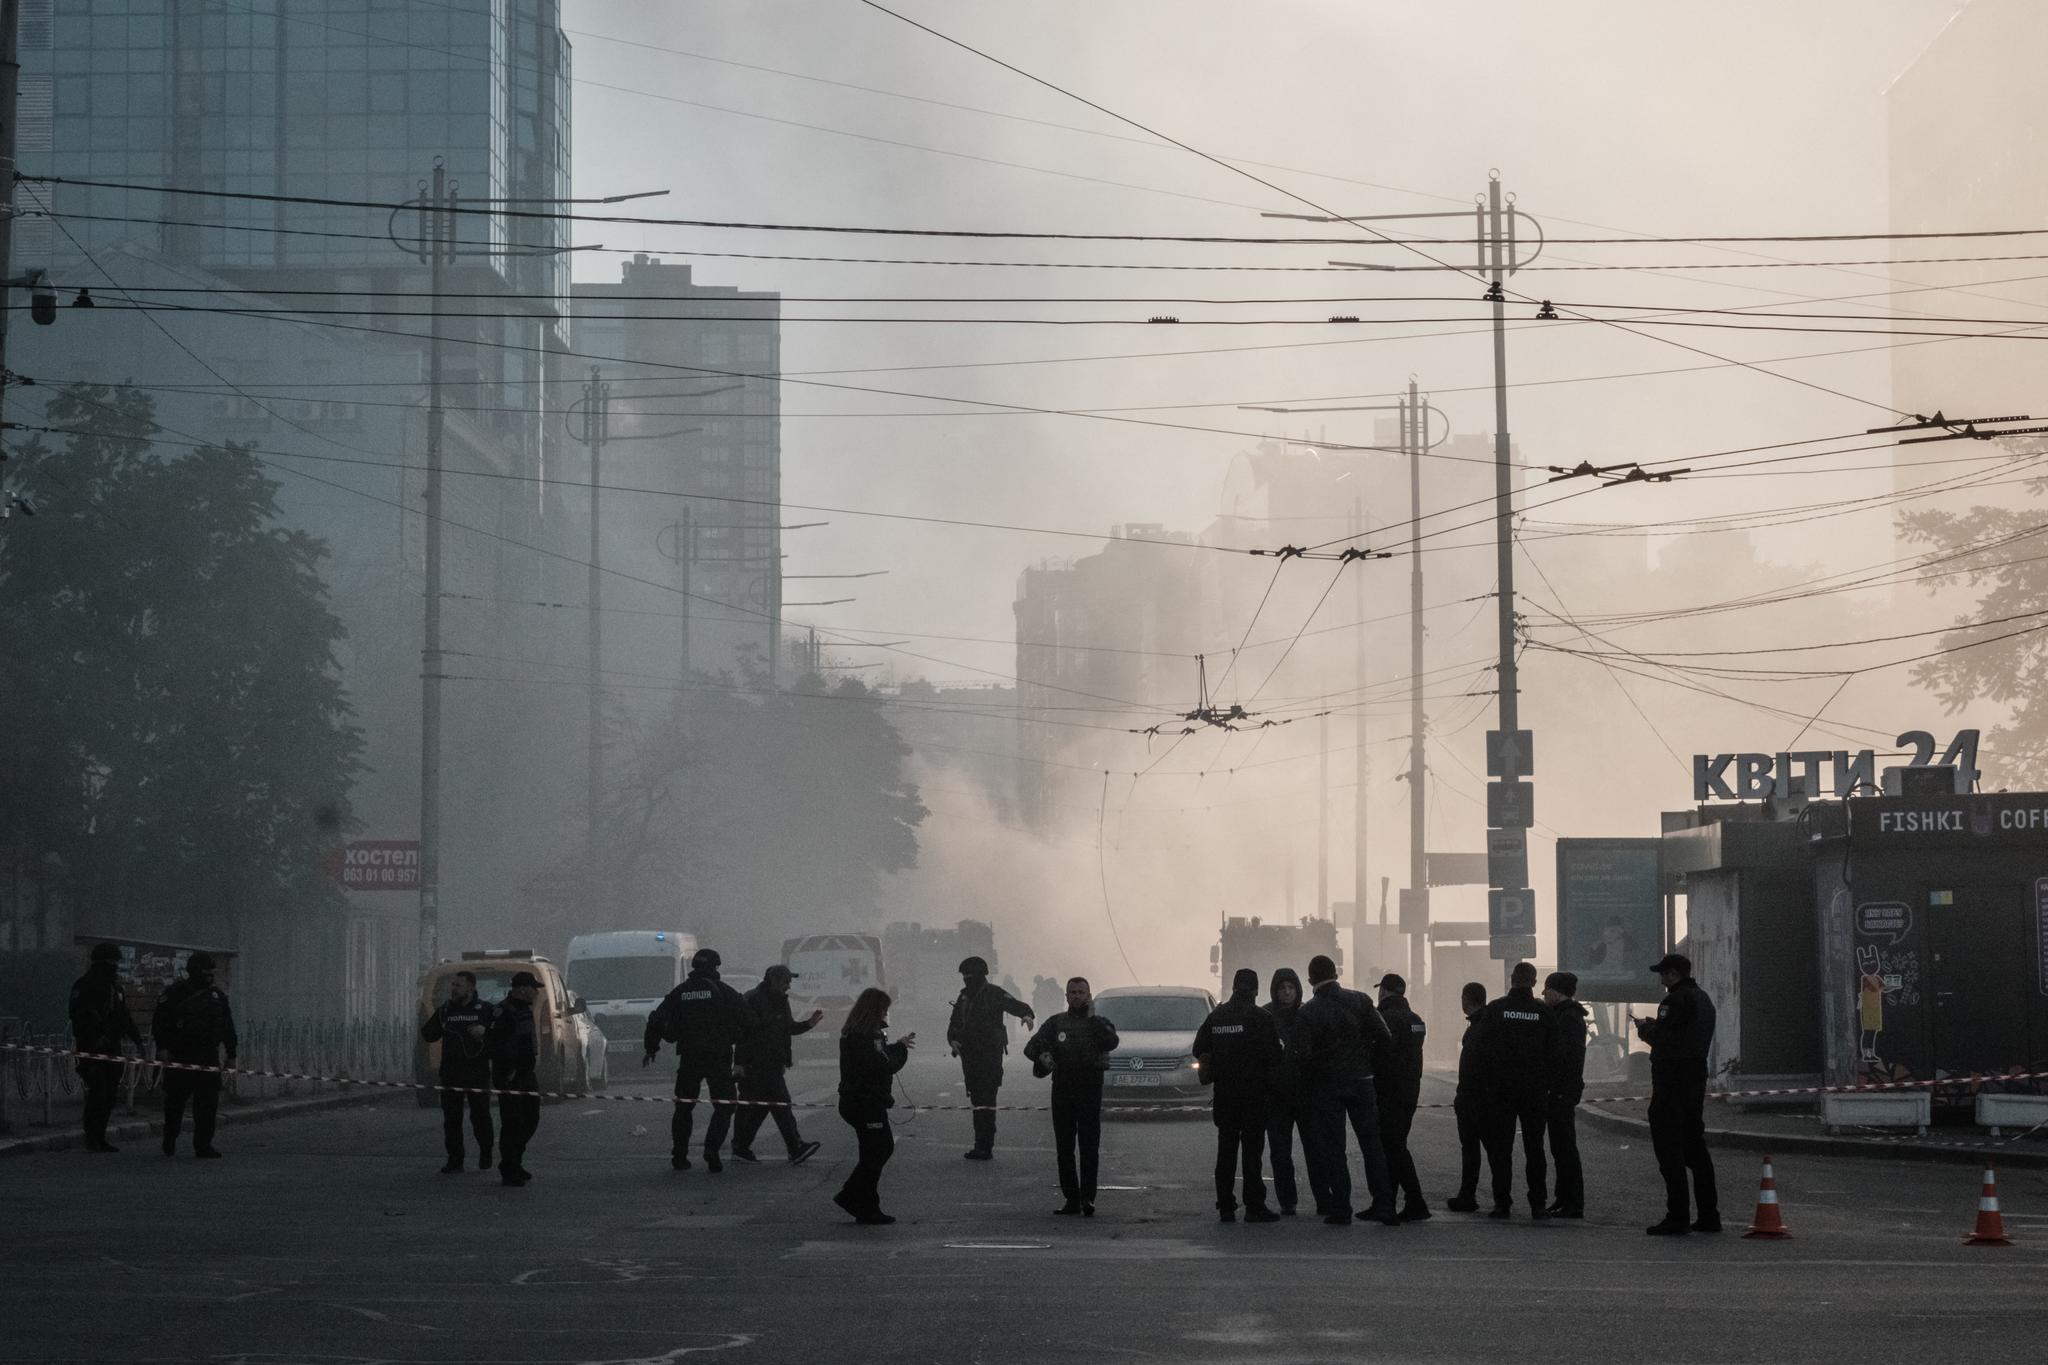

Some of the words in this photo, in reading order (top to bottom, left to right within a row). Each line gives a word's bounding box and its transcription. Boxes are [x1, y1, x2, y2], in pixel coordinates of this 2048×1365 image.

[1693, 749, 1875, 801] КВІТИ
[1896, 729, 1980, 795] 24
[1880, 810, 1964, 833] FISHKI
